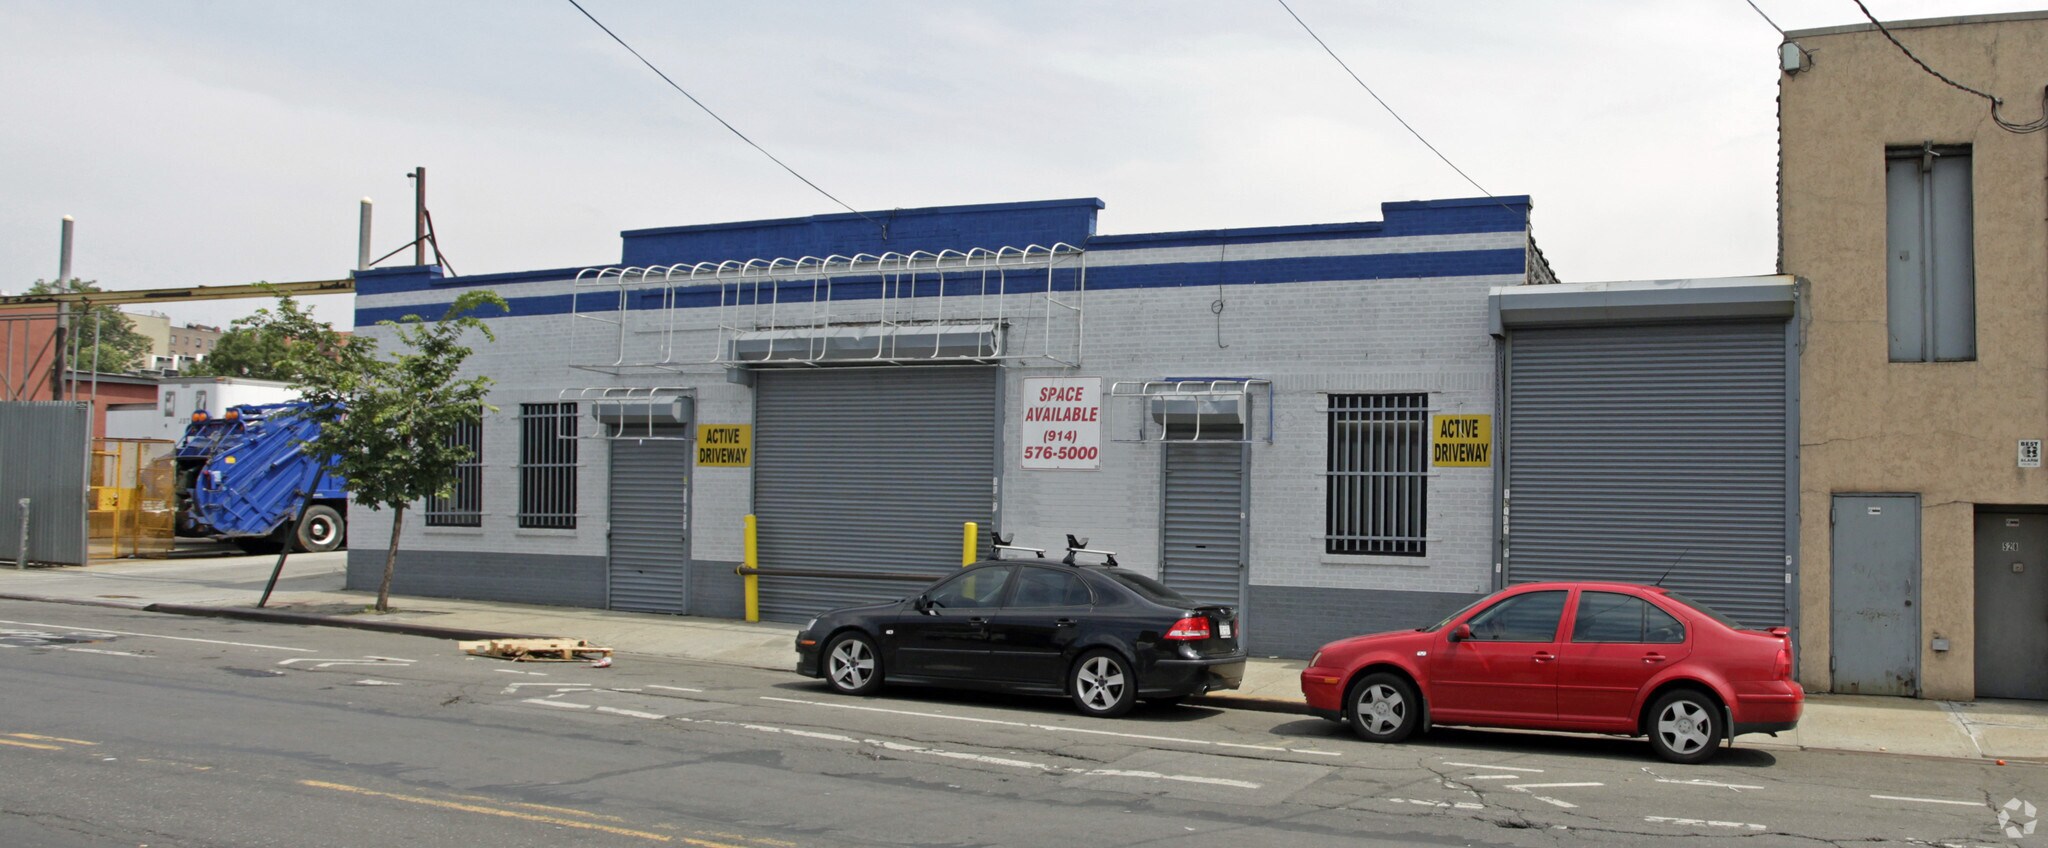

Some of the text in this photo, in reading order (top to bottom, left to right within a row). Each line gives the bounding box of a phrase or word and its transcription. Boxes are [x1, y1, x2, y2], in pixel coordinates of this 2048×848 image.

[1039, 387, 1084, 402] SPACE
[1025, 407, 1099, 422] AVAILABLE
[705, 428, 740, 444] ACTIVE
[1440, 419, 1478, 438] ACTIVE
[1043, 430, 1077, 444] (914)
[699, 447, 748, 463] DRIVEWAY
[1024, 446, 1098, 460] 576-5000
[1434, 443, 1489, 462] DRIVEWAY
